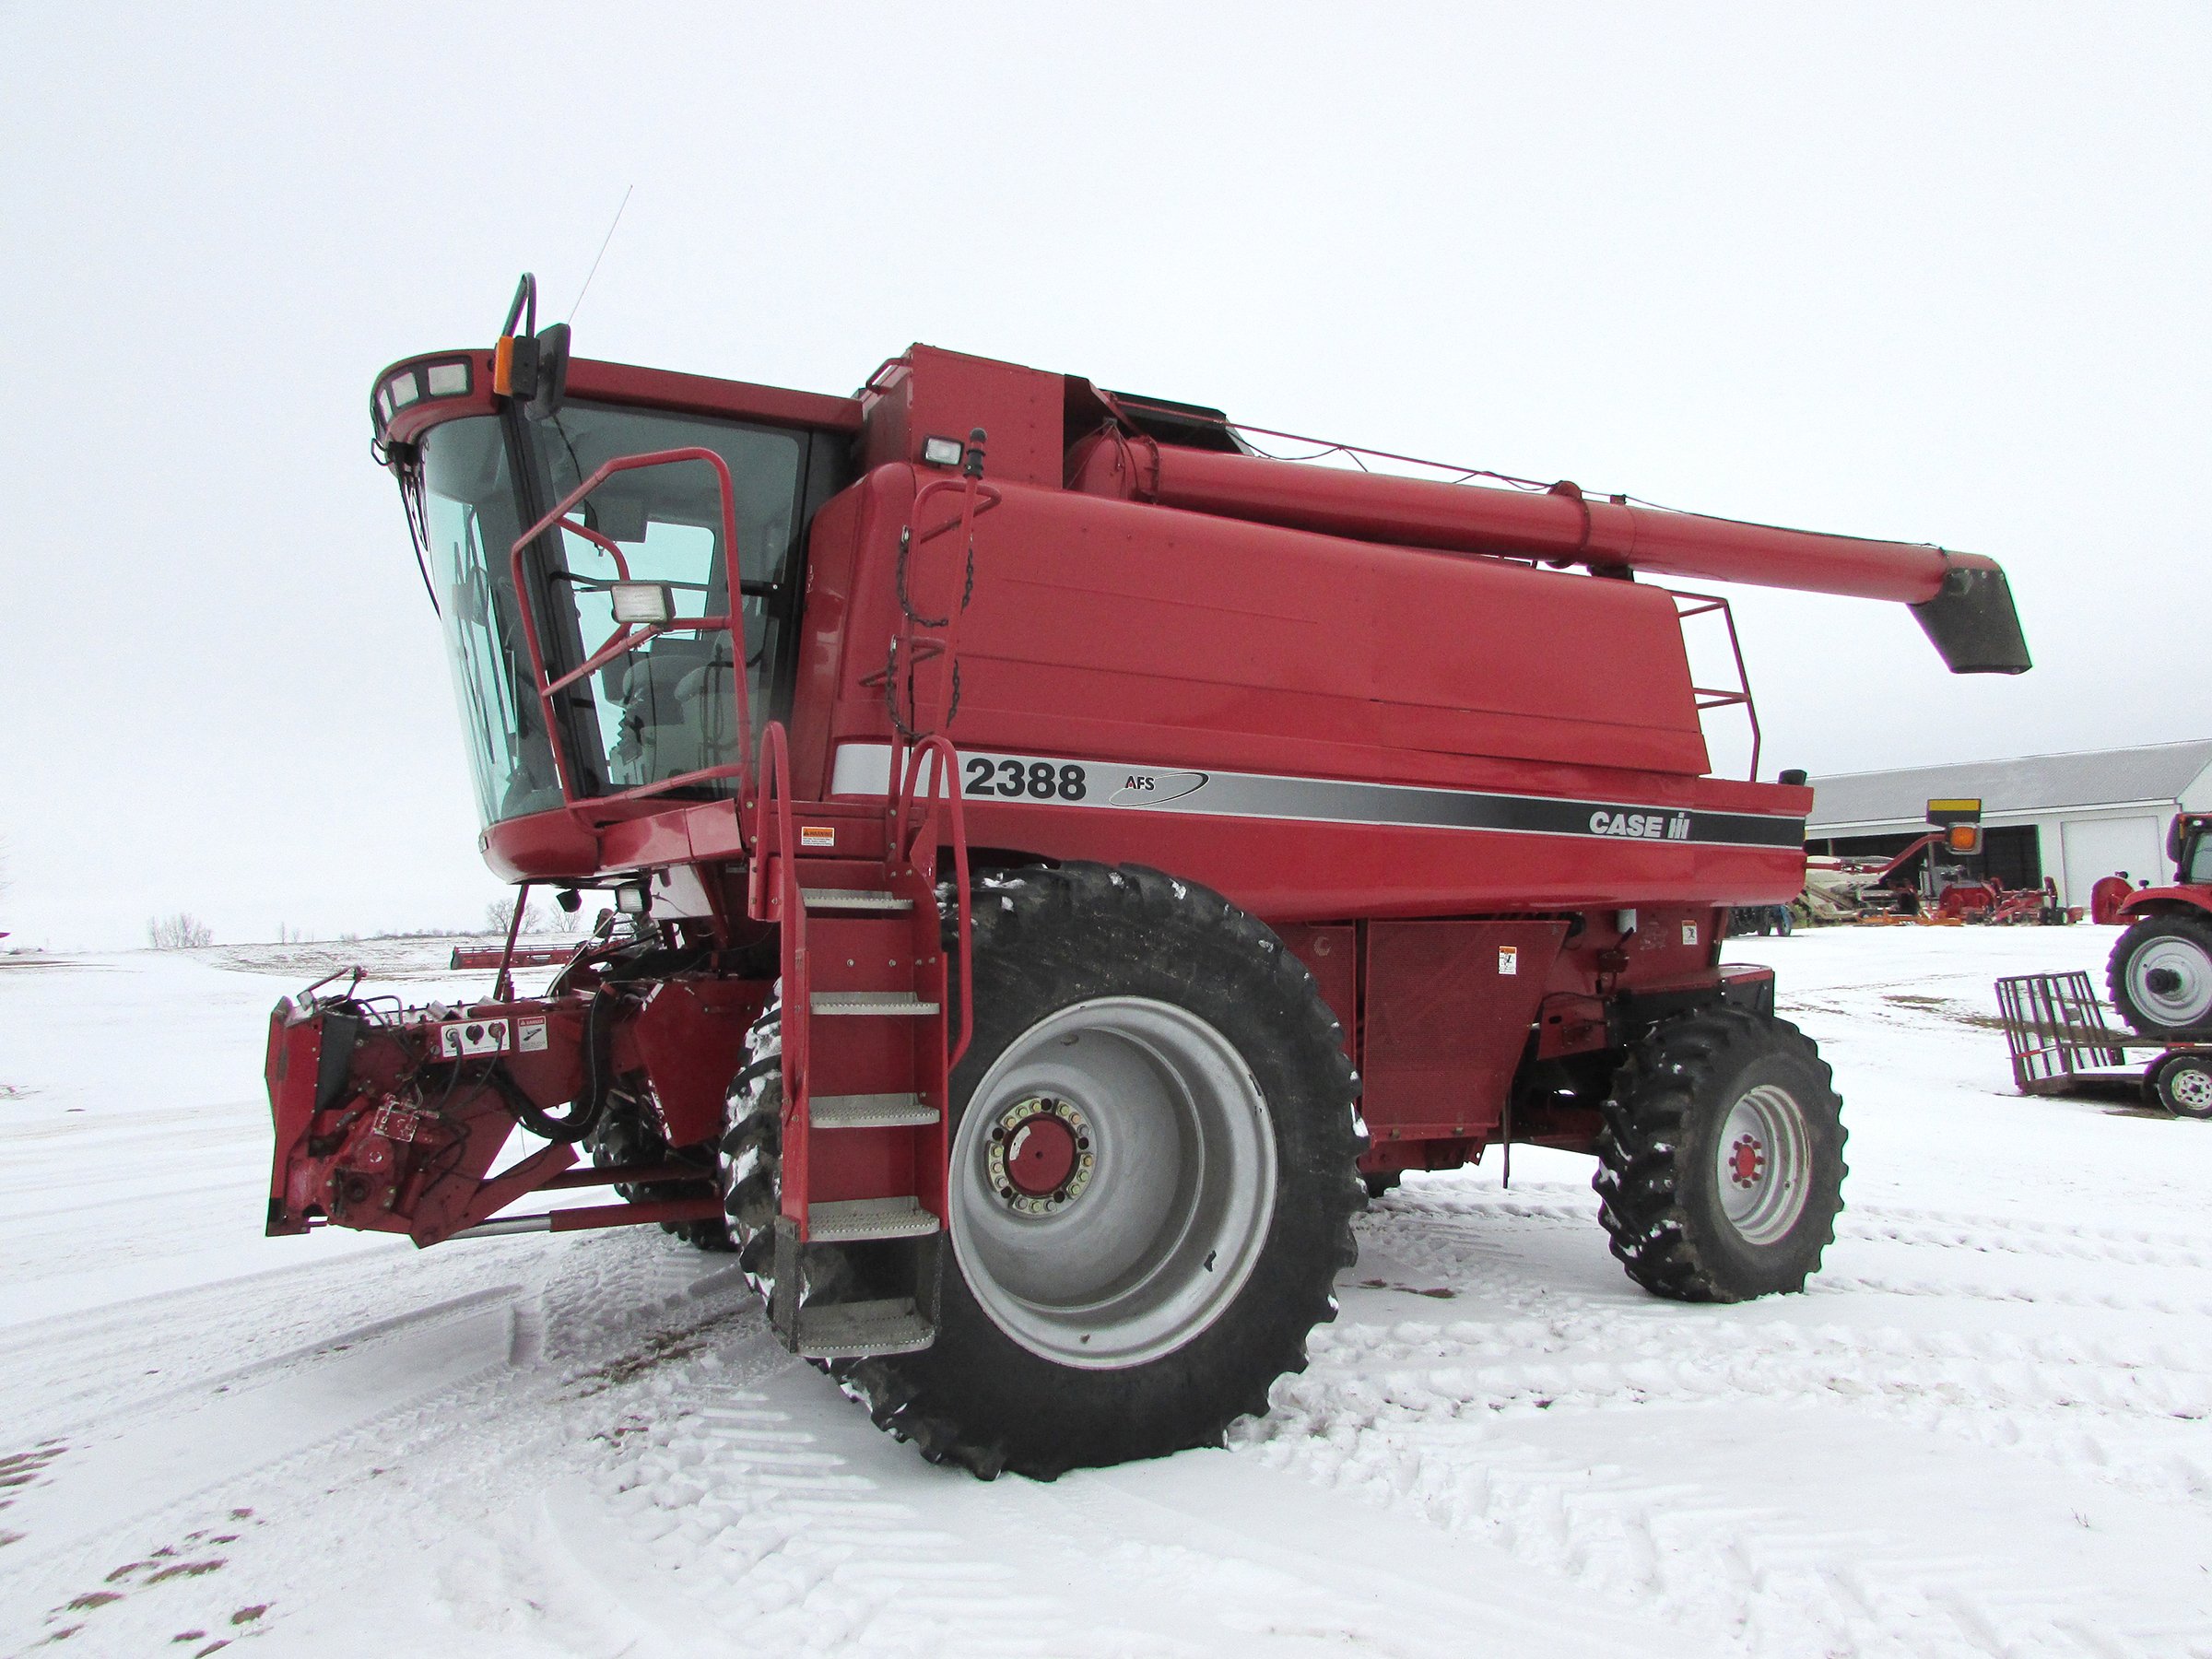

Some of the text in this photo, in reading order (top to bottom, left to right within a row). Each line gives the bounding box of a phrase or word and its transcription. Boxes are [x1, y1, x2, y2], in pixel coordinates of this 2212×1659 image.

[965, 758, 1087, 801] 2388
[1124, 775, 1155, 791] AFS
[1589, 811, 1664, 838] CASE
